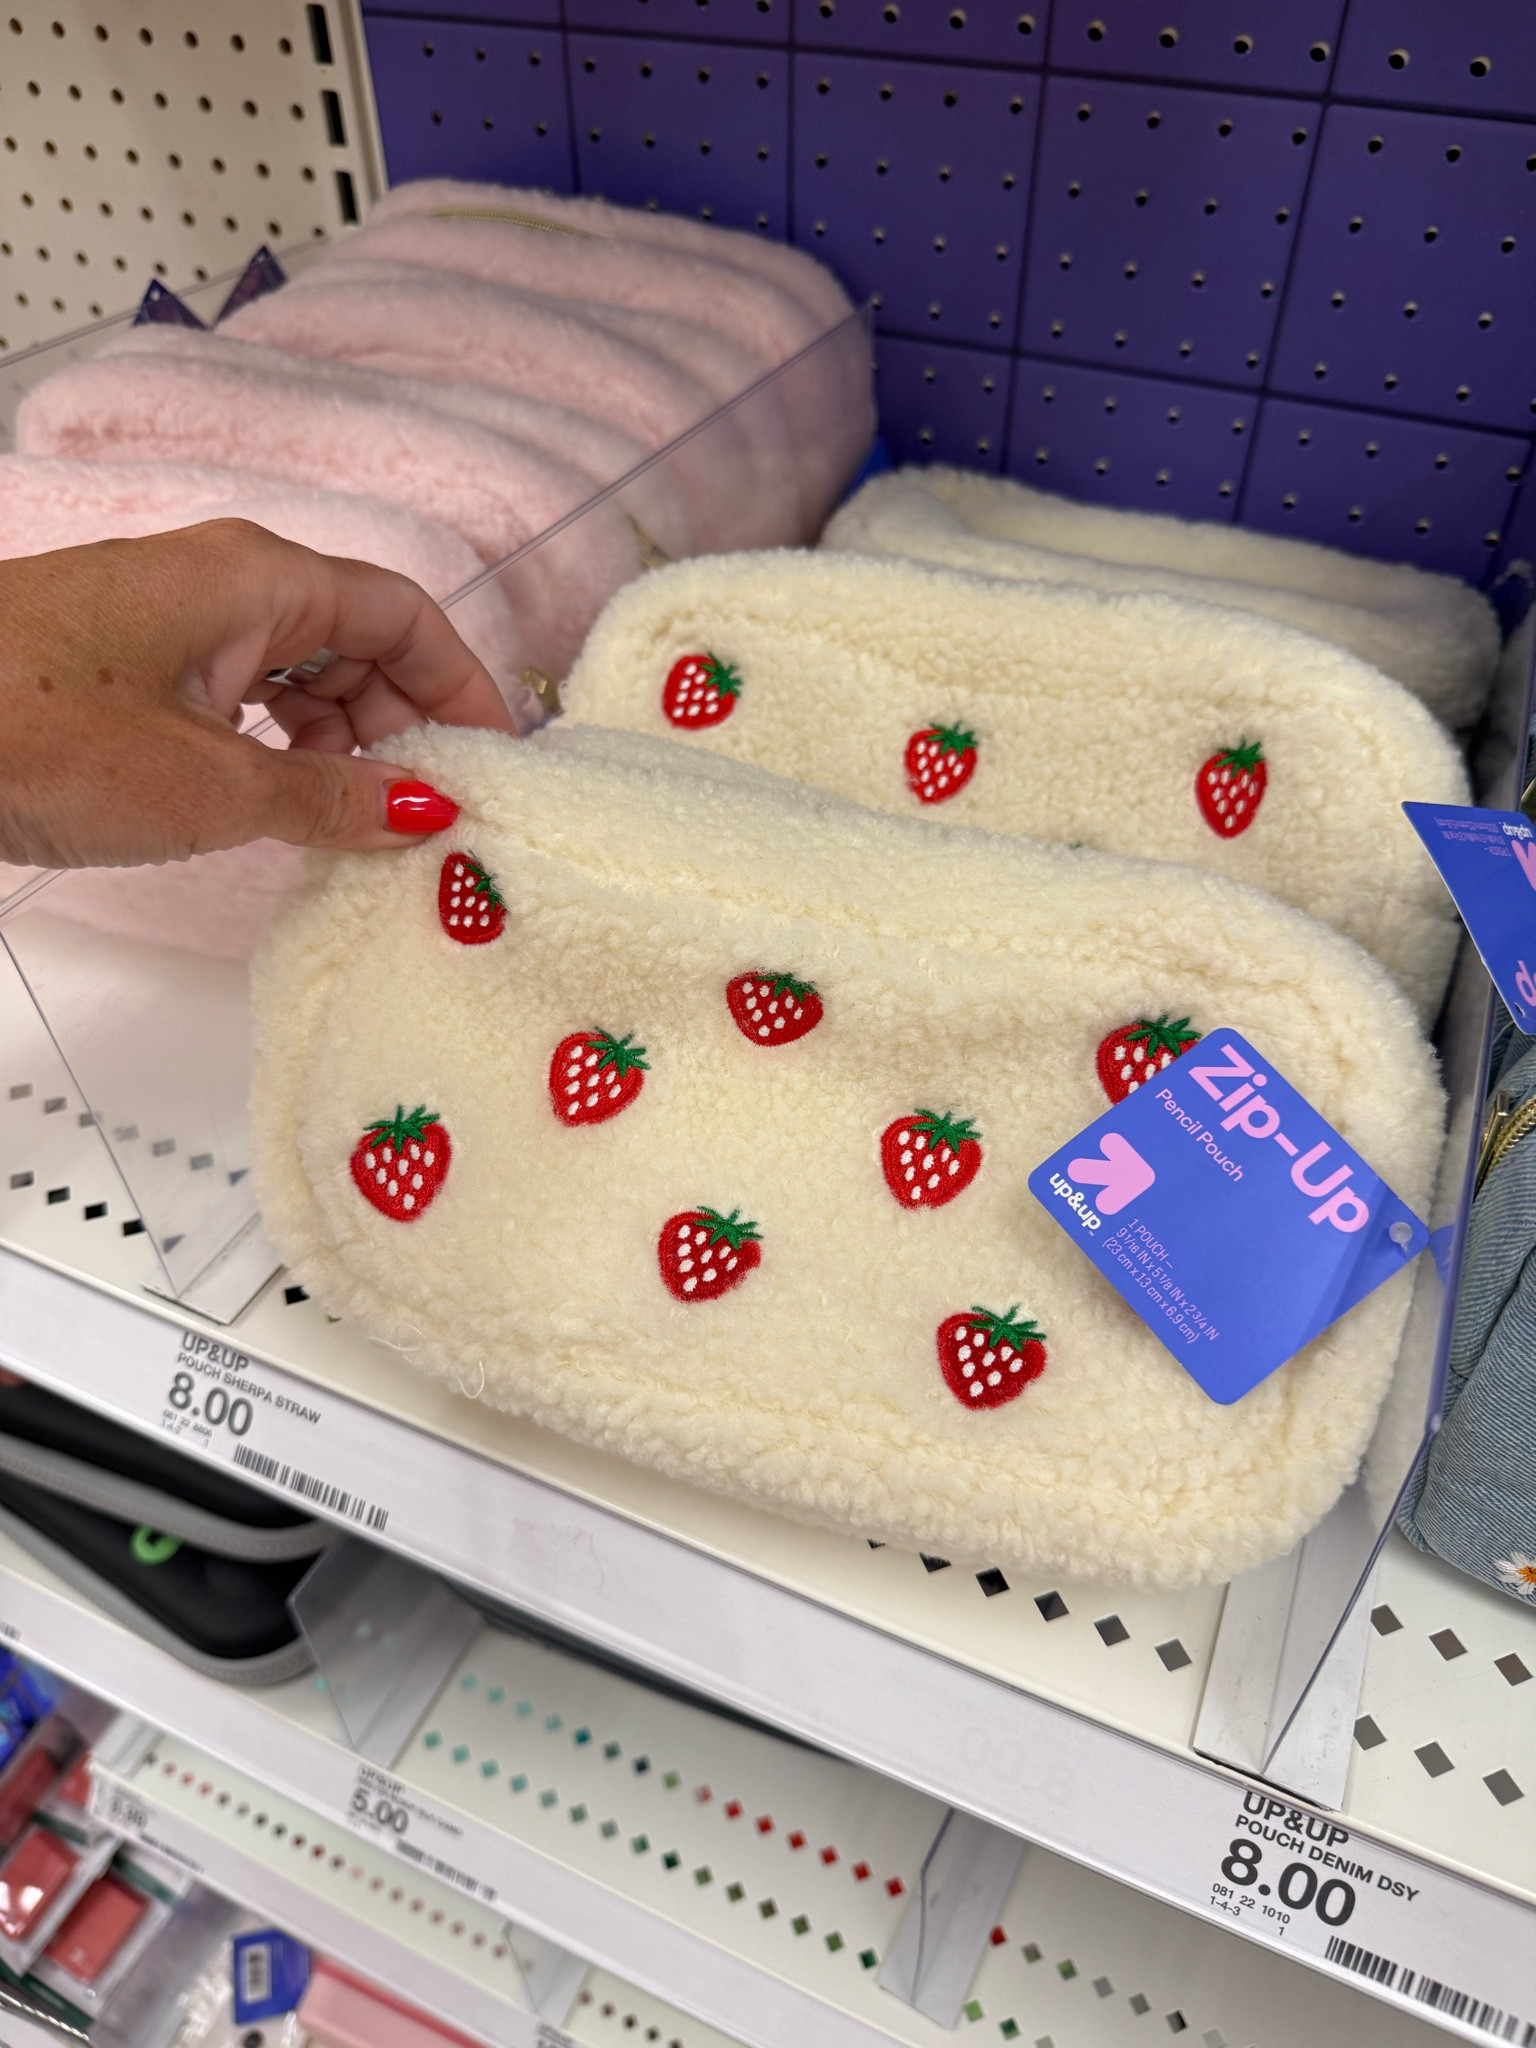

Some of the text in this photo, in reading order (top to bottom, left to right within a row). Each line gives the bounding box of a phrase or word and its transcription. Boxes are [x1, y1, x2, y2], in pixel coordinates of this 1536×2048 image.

[1155, 1088, 1243, 1182] Pencil Pouch
[1187, 1043, 1369, 1232] Zip-Up
[1049, 1172, 1102, 1231] up&up
[1128, 1218, 1139, 1230] 1
[1134, 1225, 1169, 1261] POUCH
[1102, 1236, 1200, 1344] (23 cm x 13 cm x 6.9 cm)
[1136, 1250, 1152, 1265] IN
[1145, 1261, 1155, 1271] x
[1168, 1286, 1185, 1301] IN
[1179, 1299, 1188, 1308] x
[1203, 1325, 1220, 1341] IN
[181, 1331, 250, 1372] UP&UP
[168, 1371, 254, 1436] 8.00
[177, 1351, 322, 1424] POUCH SHERPA STRAW
[352, 1786, 409, 1833] 5.00
[1243, 1790, 1350, 1847] UP&UP
[1221, 1838, 1356, 1927] 8.00
[1235, 1814, 1420, 1902] POUCH DENIM DSY
[1209, 1895, 1241, 1917] 1-4-3
[1212, 1883, 1291, 1925] 081 22 1010
